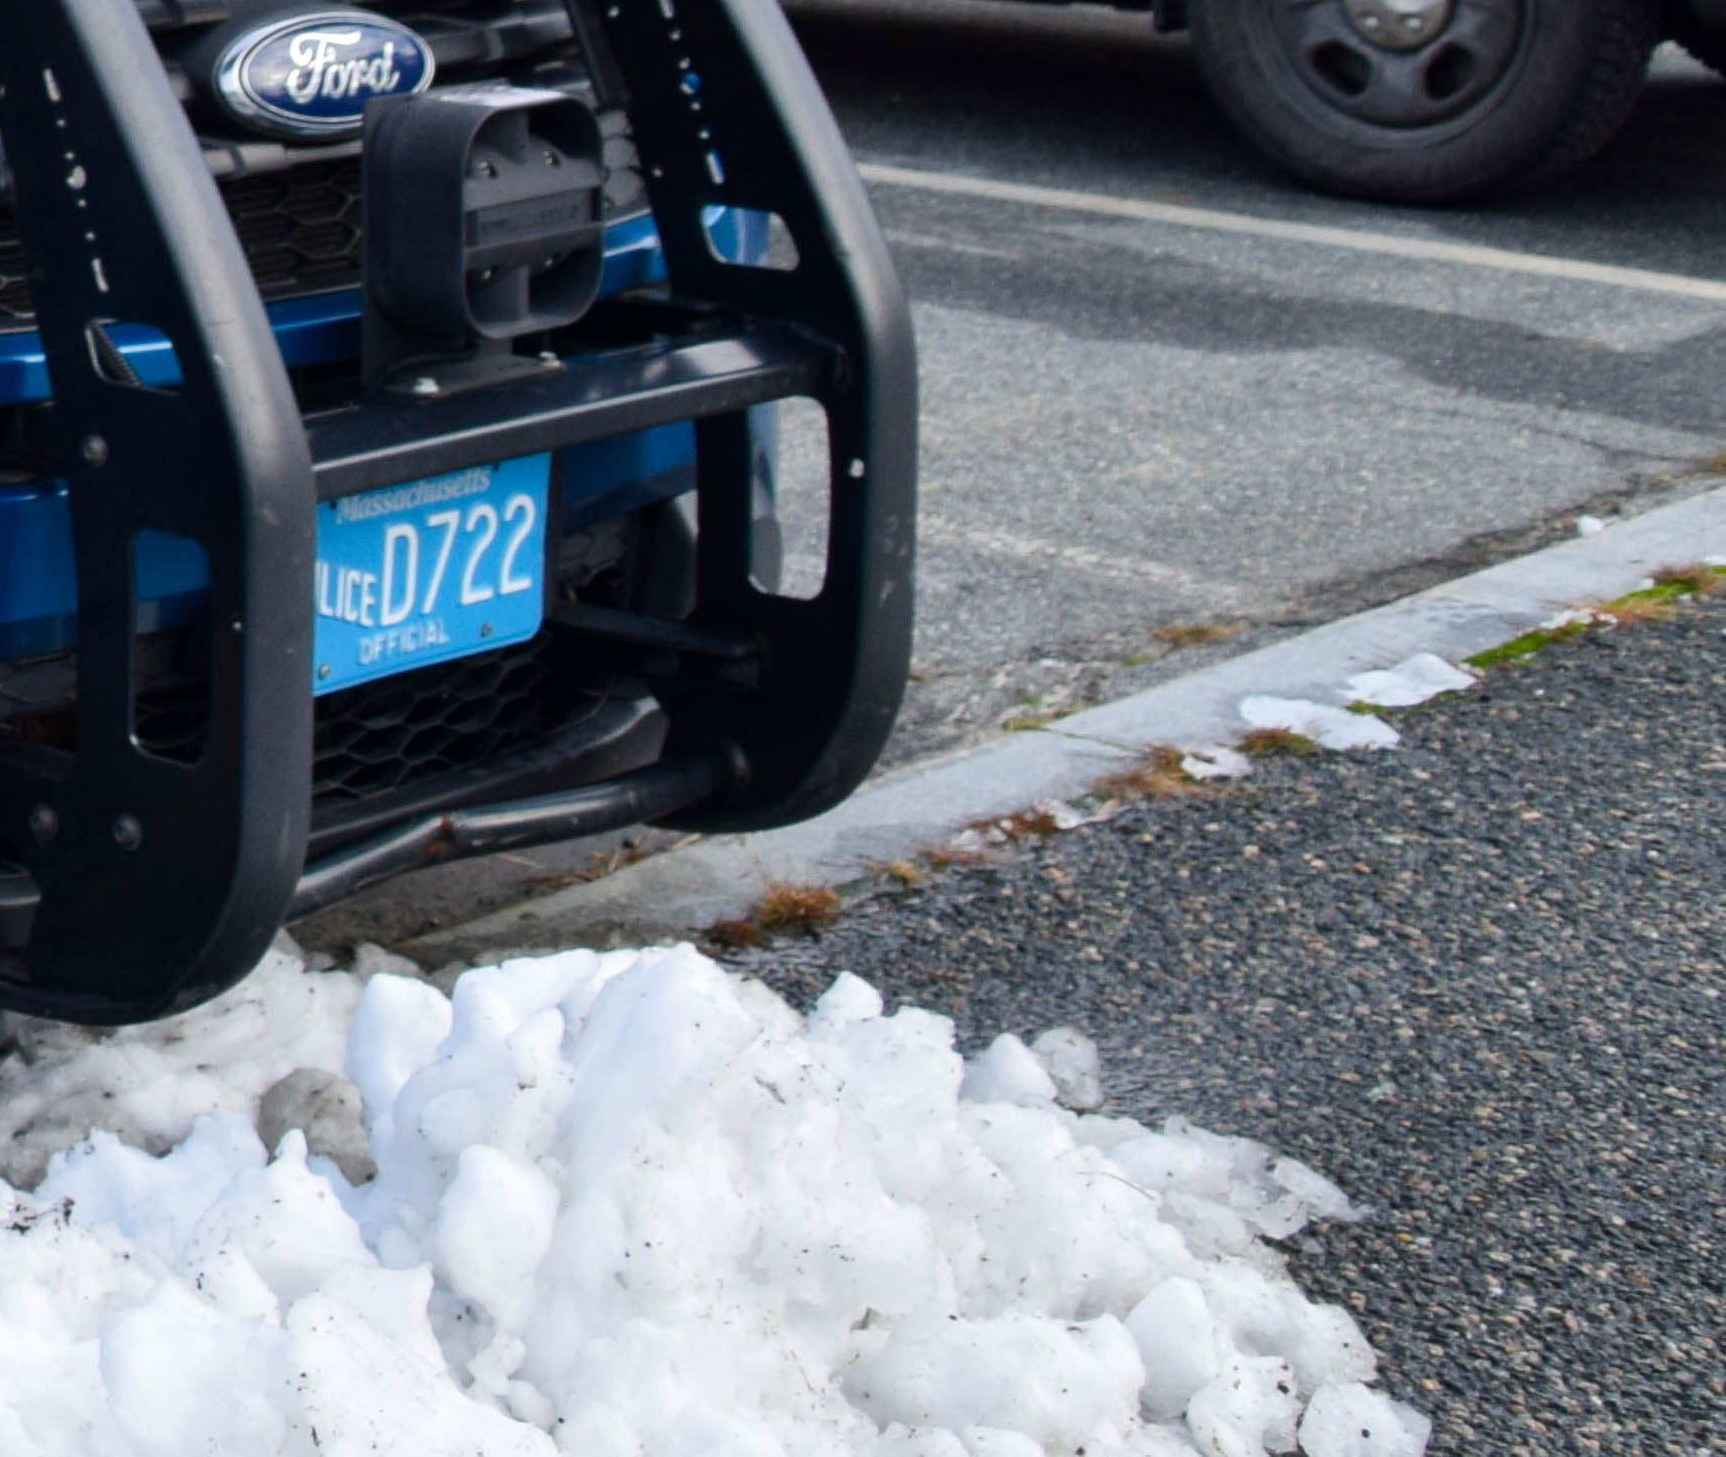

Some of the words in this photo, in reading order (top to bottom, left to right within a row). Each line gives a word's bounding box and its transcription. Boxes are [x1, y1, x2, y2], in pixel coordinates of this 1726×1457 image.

[286, 31, 400, 104] Ford
[336, 468, 492, 524] Massachusetts
[315, 560, 376, 628] LICE
[380, 493, 537, 627] D722
[358, 619, 449, 666] OFFICIAL
